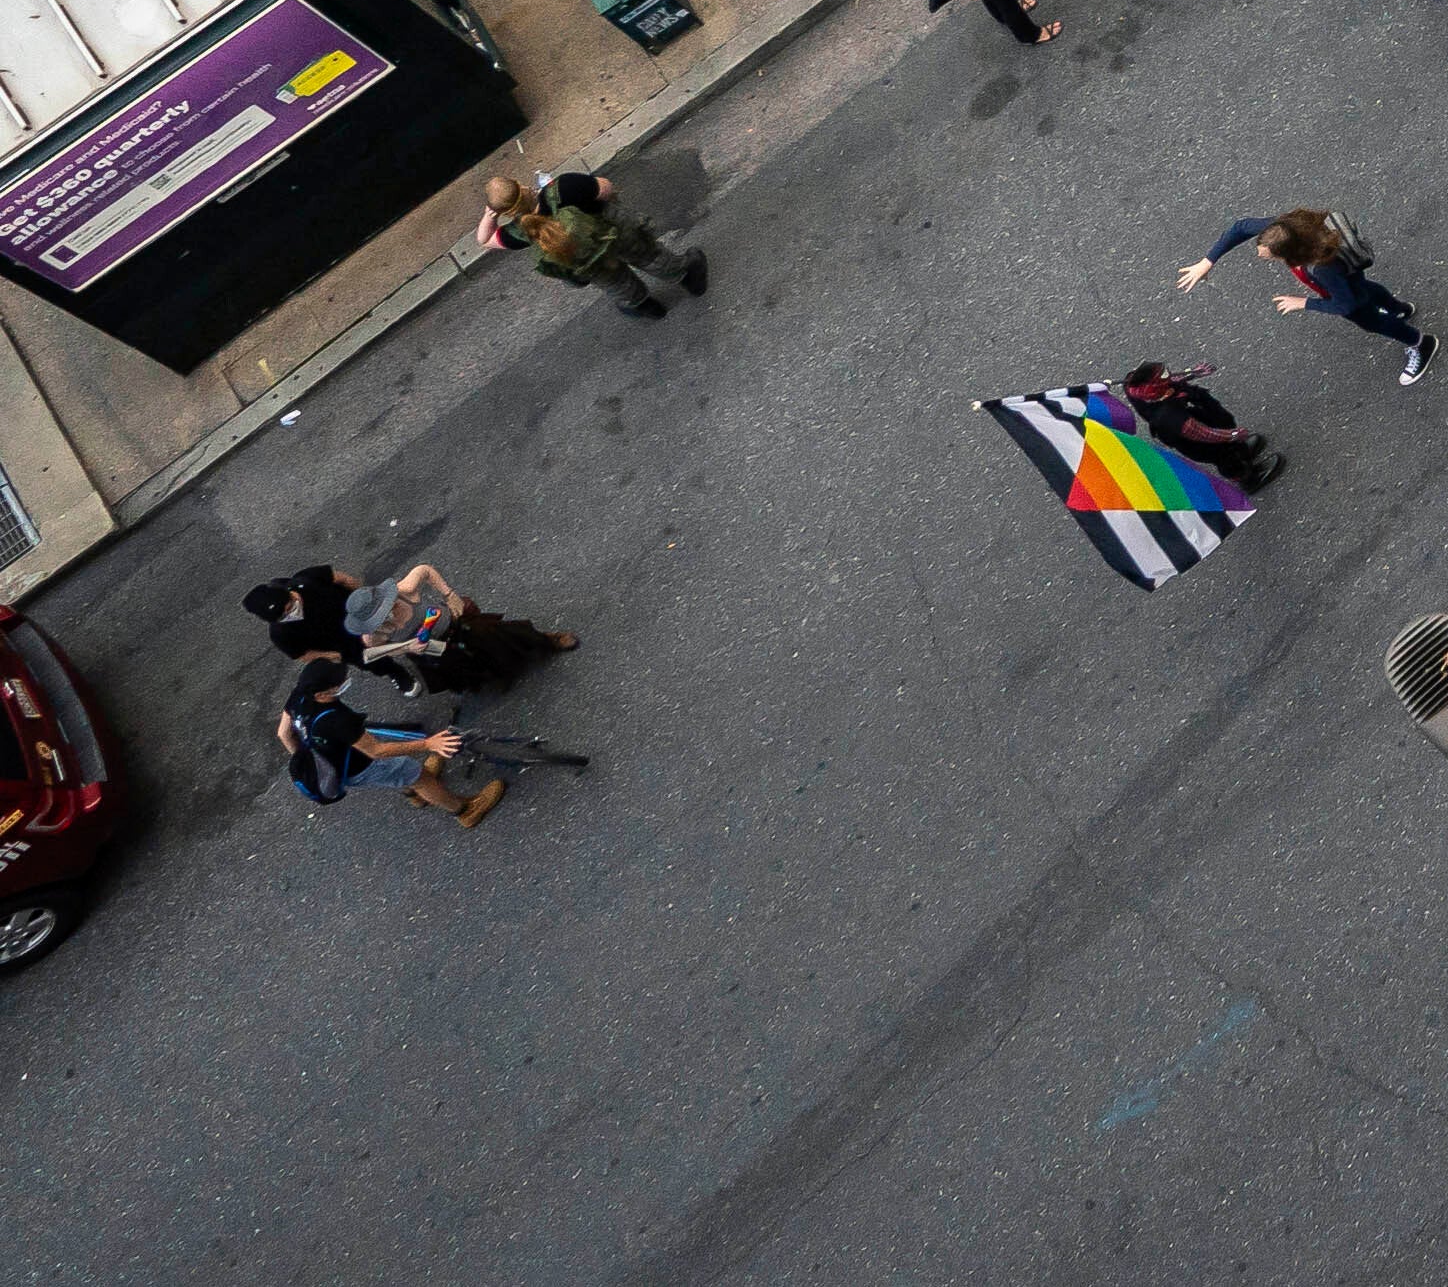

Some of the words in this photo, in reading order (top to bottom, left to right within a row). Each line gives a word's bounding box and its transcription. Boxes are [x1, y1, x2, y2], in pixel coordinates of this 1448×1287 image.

[0, 208, 39, 237] Get
[36, 168, 94, 209] $360
[93, 100, 191, 170] quarterly
[14, 163, 75, 205] Medicare
[75, 145, 100, 165] and
[99, 100, 162, 147] Medicaid?
[12, 169, 119, 245] allowance
